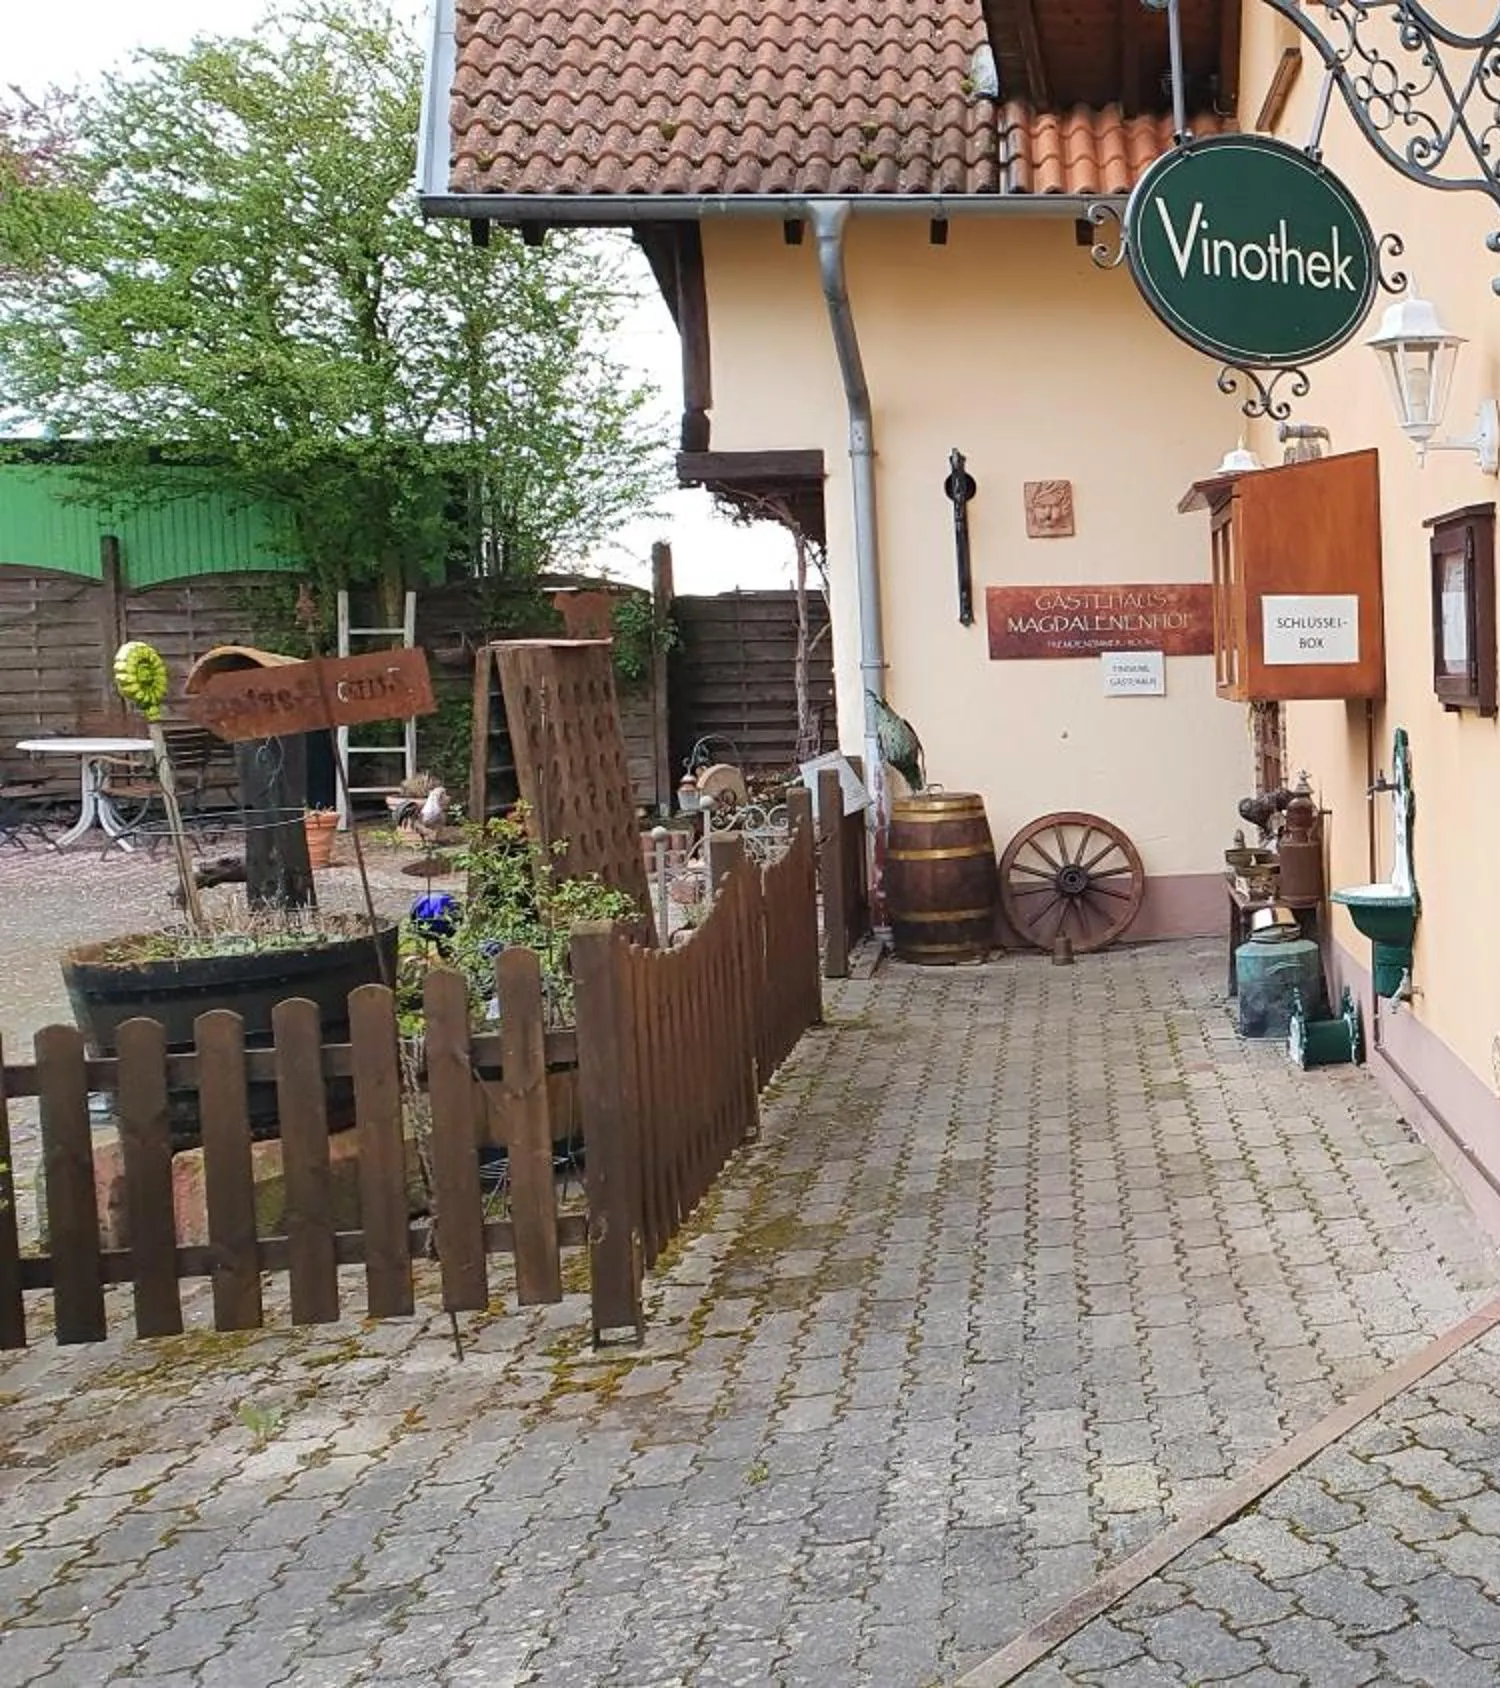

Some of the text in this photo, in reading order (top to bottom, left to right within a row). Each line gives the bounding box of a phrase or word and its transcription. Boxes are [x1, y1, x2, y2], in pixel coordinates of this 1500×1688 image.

[1155, 197, 1356, 291] Vinothek
[1035, 591, 1167, 611] GÄSTEHAUS
[1007, 611, 1193, 633] MAGDALENENHOF
[1299, 637, 1325, 649] BOX
